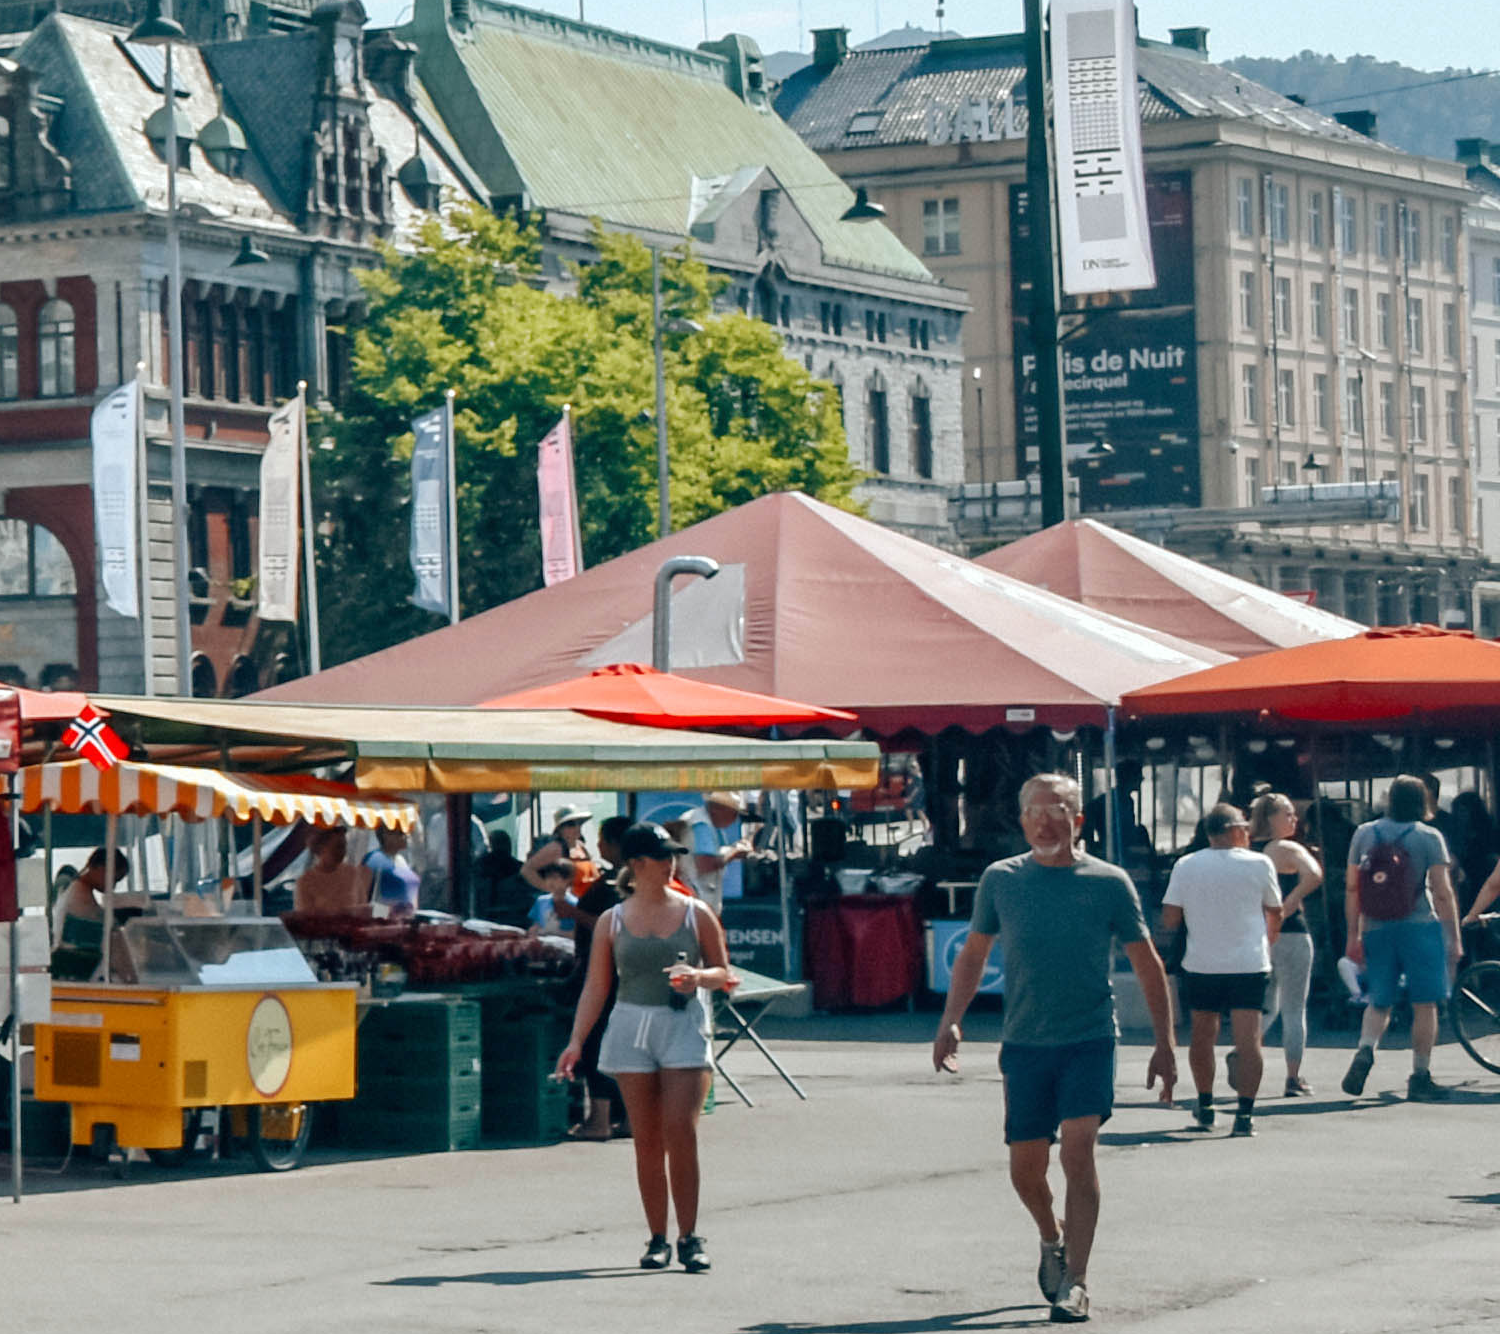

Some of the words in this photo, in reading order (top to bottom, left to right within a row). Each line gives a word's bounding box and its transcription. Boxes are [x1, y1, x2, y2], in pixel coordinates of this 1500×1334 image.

[1022, 352, 1086, 376] Pis
[1091, 349, 1123, 372] de
[1130, 345, 1186, 369] Nuit
[1064, 372, 1128, 391] ecirquel
